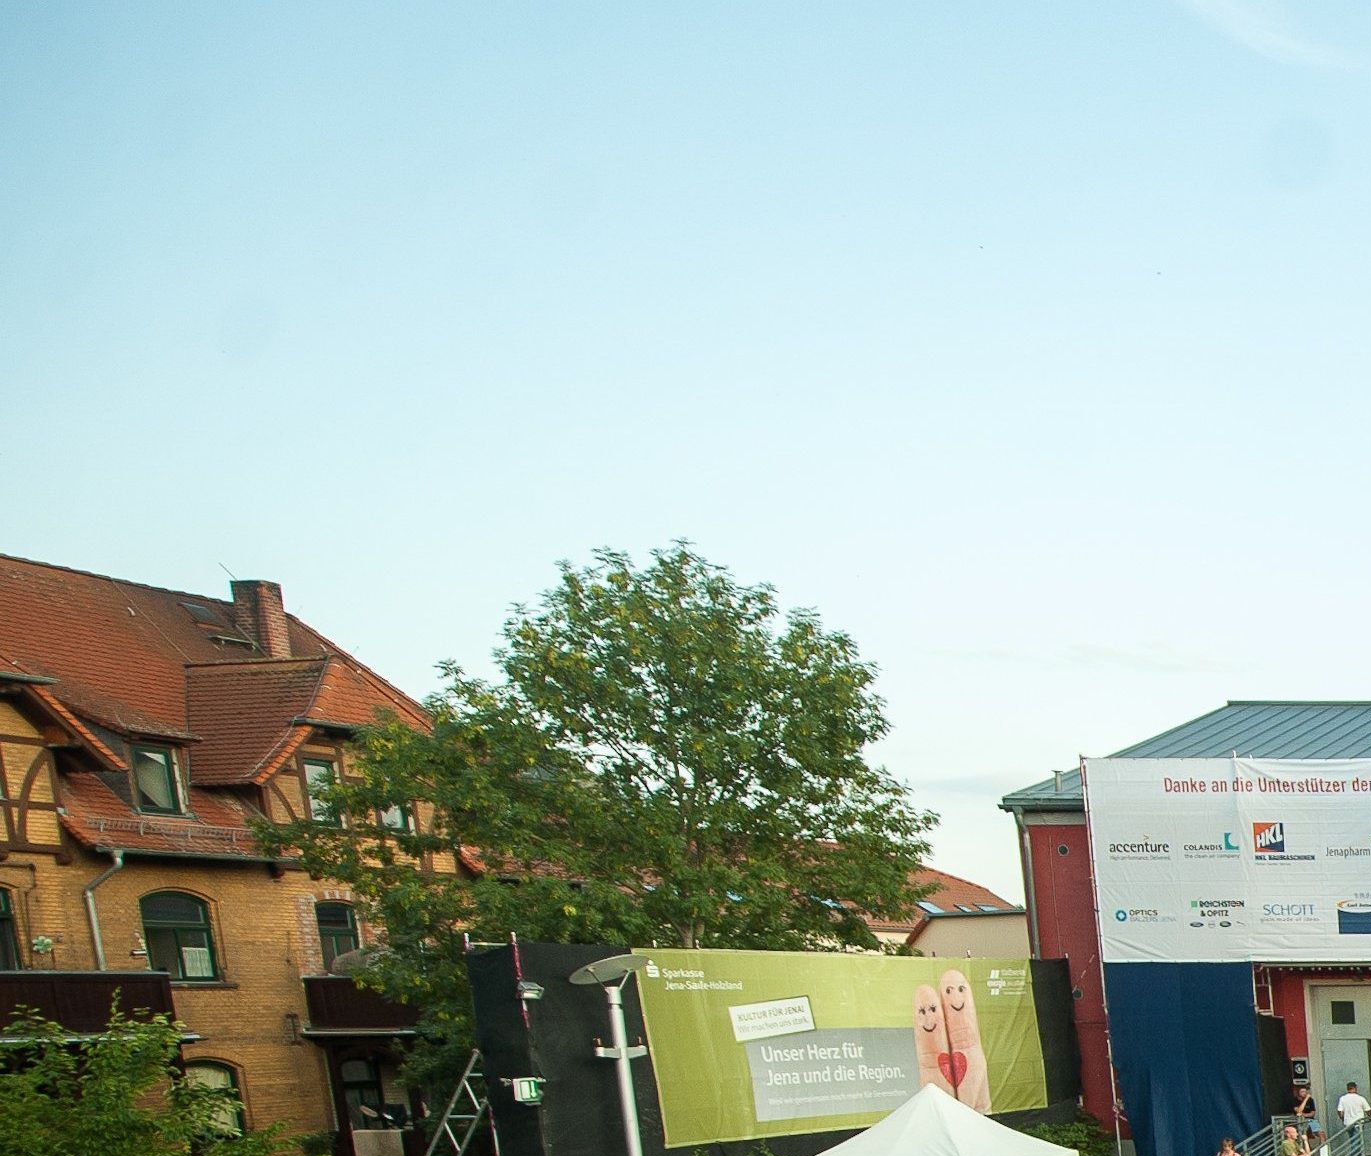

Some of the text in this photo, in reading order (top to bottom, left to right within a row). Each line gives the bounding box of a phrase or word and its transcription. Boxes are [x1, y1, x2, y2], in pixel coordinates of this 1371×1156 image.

[1163, 777, 1207, 793] Danke
[1211, 779, 1228, 793] an
[1231, 777, 1253, 792] die
[1258, 776, 1347, 793] Unterstützer
[1256, 823, 1283, 849] HKL
[1109, 841, 1170, 853] accenture
[1325, 846, 1371, 859] Jenapharm
[1263, 903, 1315, 916] SCHOTT
[661, 967, 705, 980] Sparkasse
[665, 979, 744, 992] Jena-Saale-Holzland
[737, 1009, 768, 1022] KULTUR
[767, 1007, 784, 1018] FÜR
[760, 1042, 865, 1063] Unser Herz für
[766, 1063, 906, 1087] Jena und die Region.
